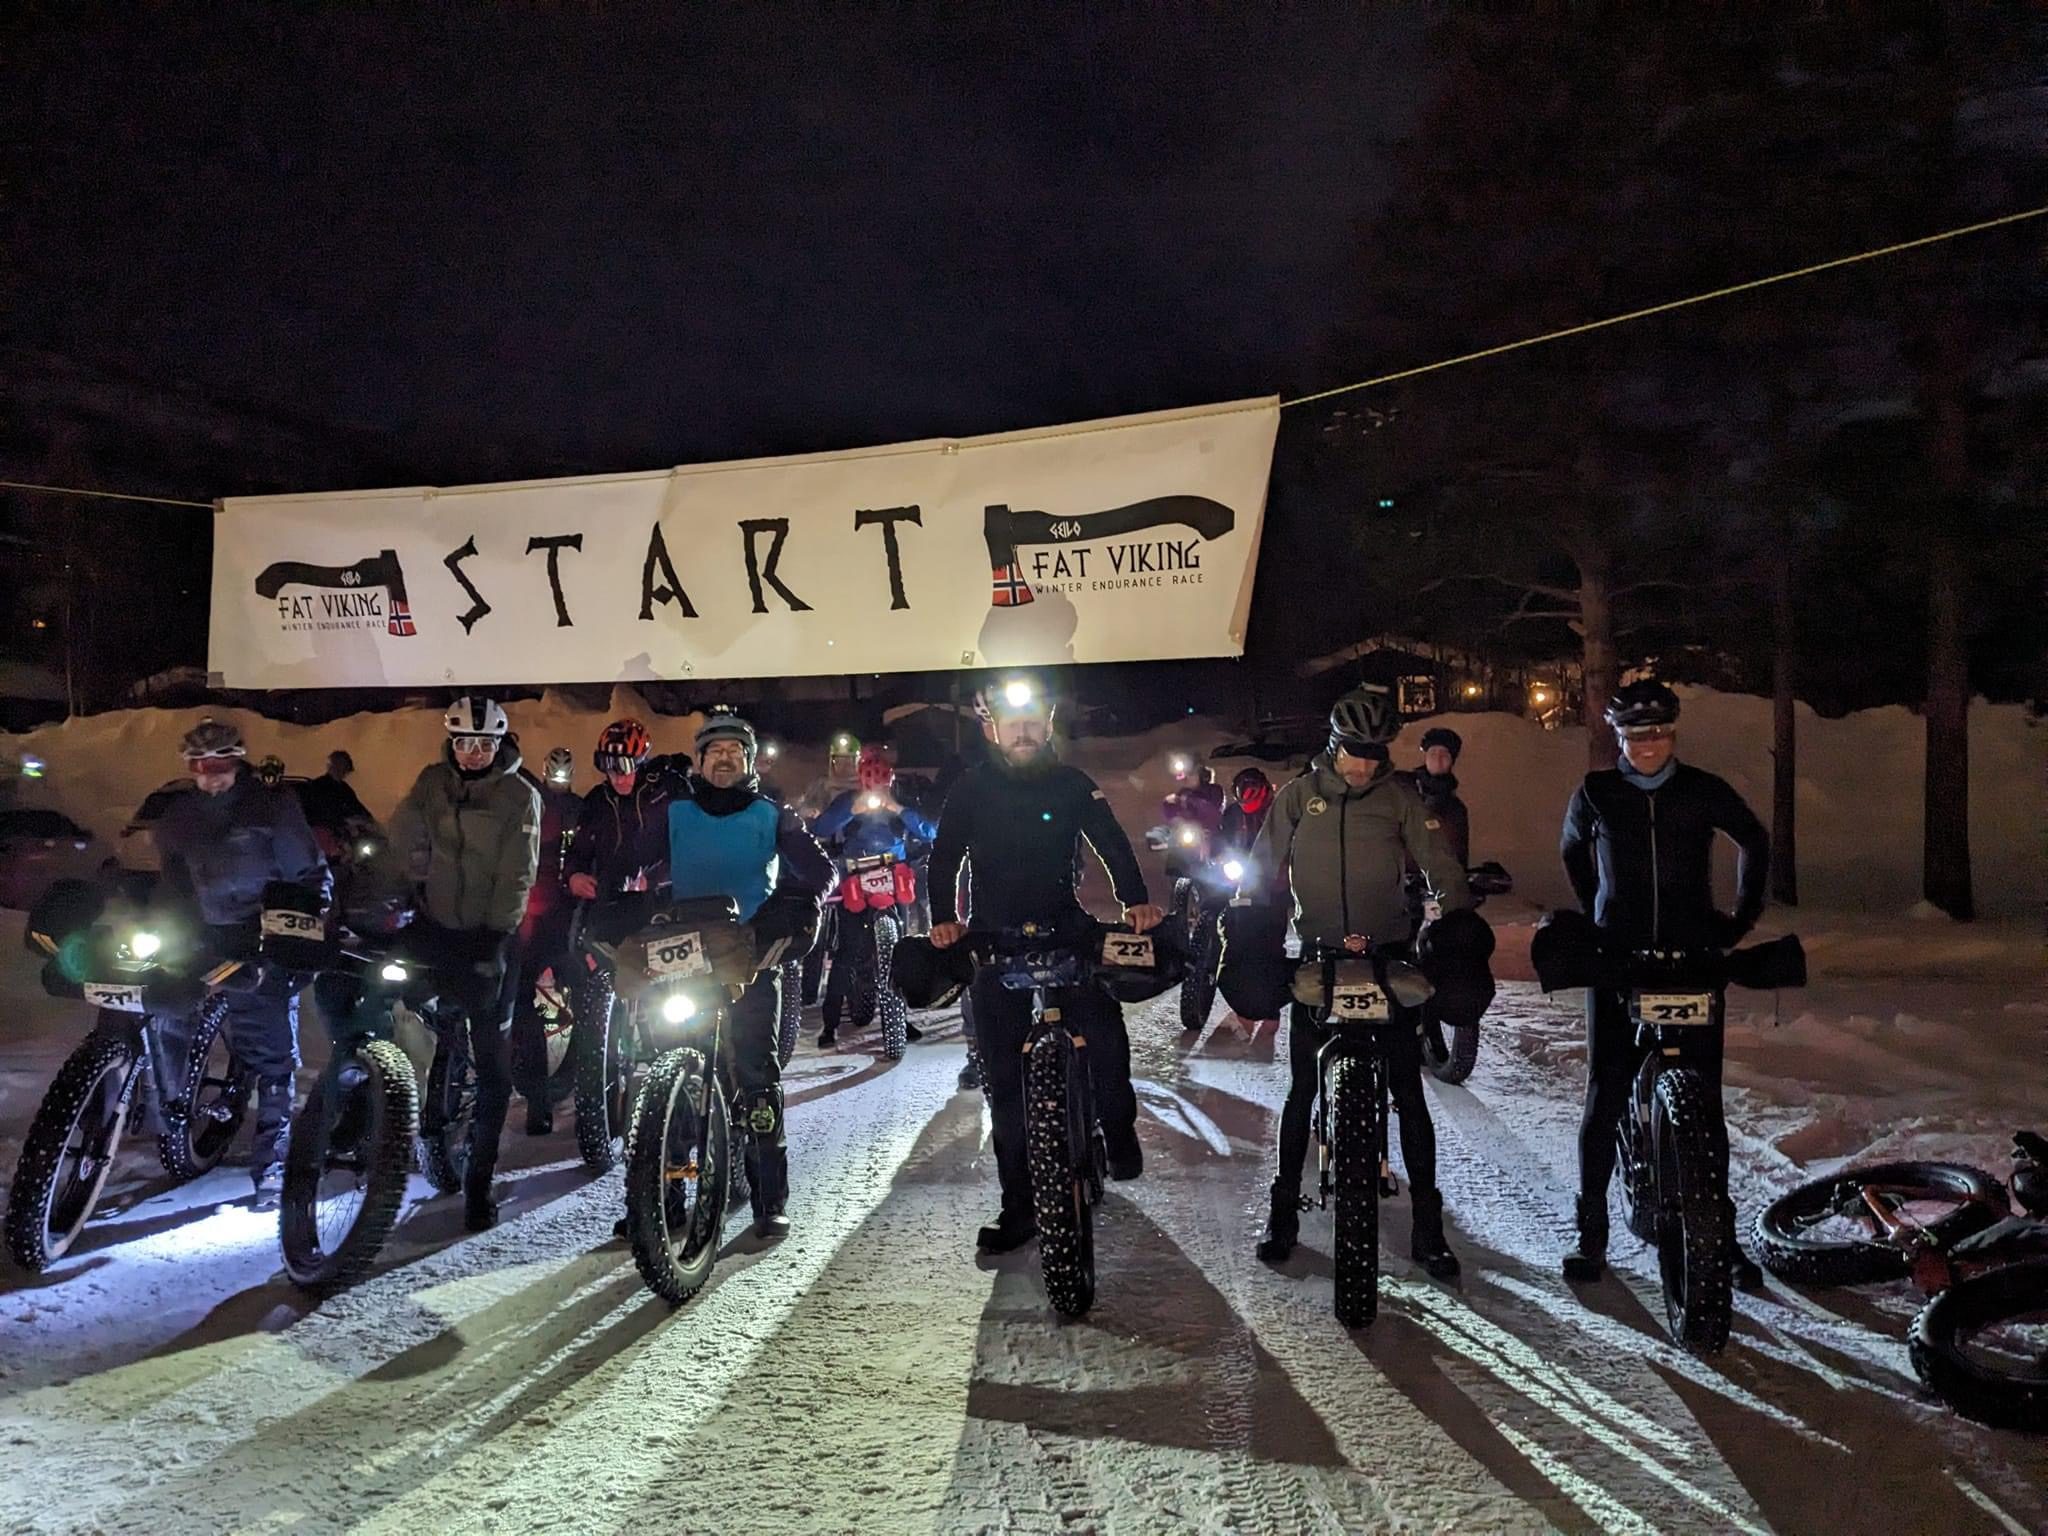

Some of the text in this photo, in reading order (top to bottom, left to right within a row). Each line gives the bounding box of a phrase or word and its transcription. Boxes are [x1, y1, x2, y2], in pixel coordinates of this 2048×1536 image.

[1049, 520, 1082, 539] GEILO
[1032, 538, 1201, 579] FAT VIKING
[443, 503, 923, 636] START
[1035, 573, 1204, 595] WINTER ENDURANCE RACE
[278, 591, 383, 620] FAT VIKING
[281, 618, 387, 632] WINTER ENDURANCE RACE
[1117, 942, 1144, 957] 22
[1342, 995, 1371, 1010] 35
[1657, 1004, 1690, 1020] 24
